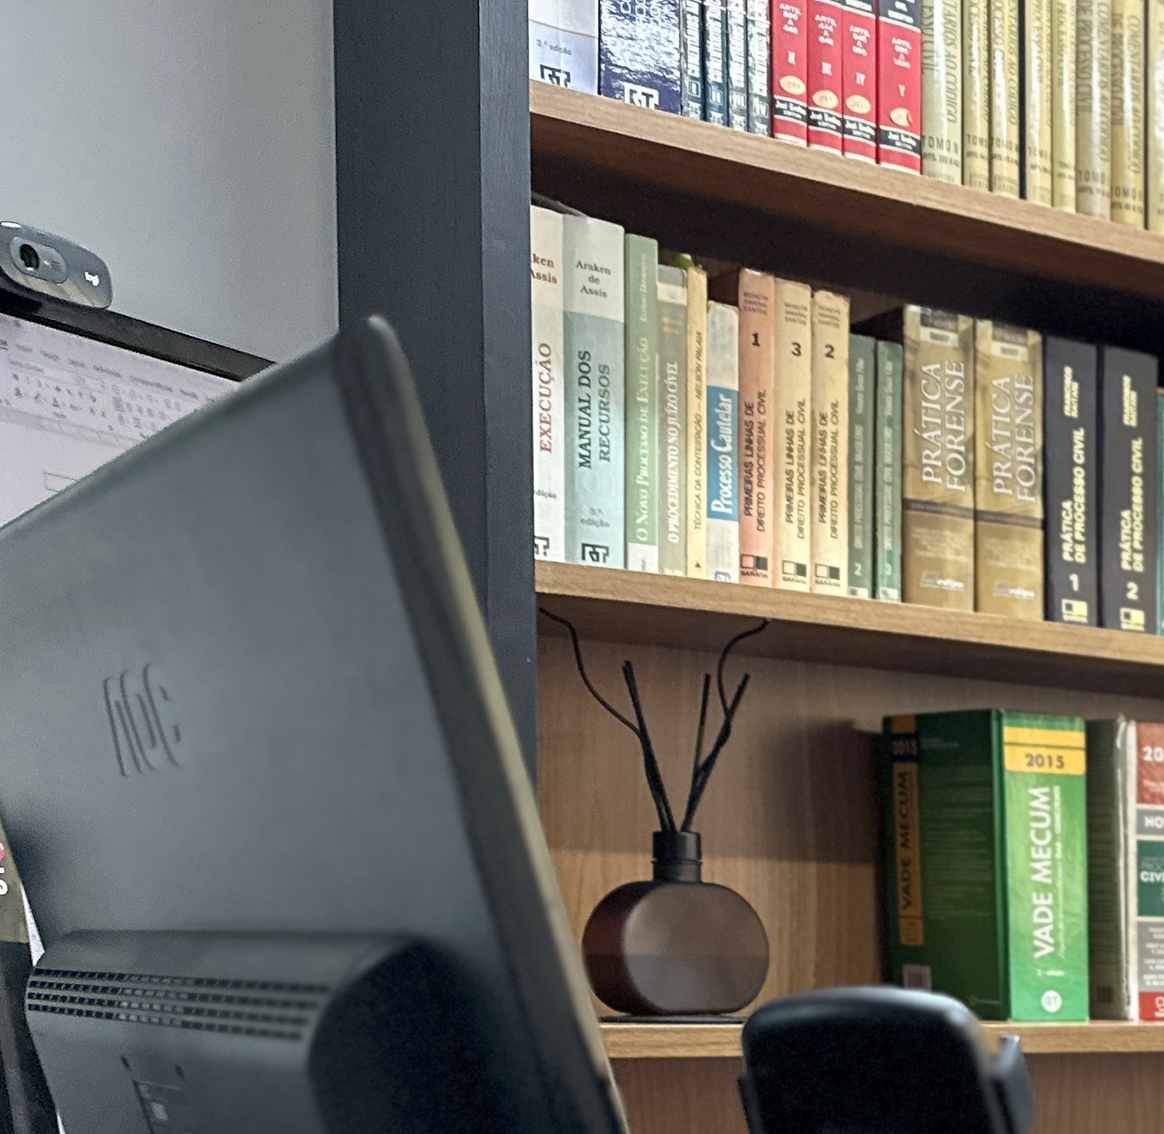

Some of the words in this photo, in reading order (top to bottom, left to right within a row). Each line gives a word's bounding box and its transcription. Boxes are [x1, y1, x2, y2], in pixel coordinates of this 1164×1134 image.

[945, 71, 959, 124] CÓDIGO
[532, 253, 555, 268] ken
[575, 260, 611, 276] Araken
[588, 275, 601, 284] de
[580, 286, 608, 298] Assis
[752, 332, 761, 347] 1
[791, 342, 802, 357] 3
[825, 344, 835, 359] 2
[578, 350, 592, 390] DOS
[664, 361, 678, 393] CÍVEL
[538, 343, 553, 454] EXECUÇÃO
[743, 401, 754, 417] DE
[756, 390, 767, 415] CIVIL
[1064, 365, 1073, 416] FRANCISCO
[1122, 374, 1132, 426] FRANCISCO
[598, 364, 612, 463] RECURSOS
[666, 394, 681, 428] JUÍZO
[710, 393, 732, 453] Cautelar
[785, 410, 795, 426] DE
[796, 398, 806, 424] CIVIL
[818, 411, 828, 427] DE
[829, 399, 839, 425] CIVIL
[914, 362, 943, 485] PRÁTICA
[945, 360, 967, 493] FORENSE
[578, 394, 593, 469] MANUAL
[667, 428, 679, 444] NO
[693, 413, 704, 477] CONTESTAÇÃO
[743, 420, 754, 457] LINHAS
[785, 428, 795, 465] LINHAS
[818, 429, 828, 467] LINHAS
[985, 376, 1013, 496] PRÁTICA
[1015, 374, 1036, 504] FORENSE
[1072, 427, 1085, 464] CIVIL
[756, 419, 767, 488] PROCESSUAL
[796, 429, 806, 497] PROCESSUAL
[829, 429, 839, 497] PROCESSUAL
[1131, 436, 1144, 474] CIVIL
[533, 488, 557, 499] dição
[667, 446, 680, 533] PROCEDIMENTO
[694, 479, 702, 491] DA
[711, 456, 733, 514] Processo
[743, 461, 754, 516] PRIMEIRAS
[785, 469, 795, 524] PRIMEIRAS
[818, 470, 828, 524] PRIMEIRAS
[693, 492, 702, 531] TÉCNICA
[756, 492, 767, 532] DIREITO
[796, 500, 806, 539] DIREITO
[829, 500, 839, 539] DIREITO
[1073, 467, 1086, 542] PROCESSO
[1131, 475, 1144, 551] PROCESSO
[668, 533, 679, 543] O
[1060, 500, 1074, 563] PRÁTICA
[1119, 509, 1132, 572] PRÁTICA
[854, 562, 862, 576] 2
[884, 562, 892, 576] 3
[1073, 544, 1086, 564] DE
[1132, 553, 1144, 573] DE
[1070, 573, 1079, 591] 1
[1126, 582, 1139, 600] 2
[1024, 754, 1065, 770] 2015
[1028, 786, 1053, 885] MECUM
[1031, 891, 1055, 959] VADE
